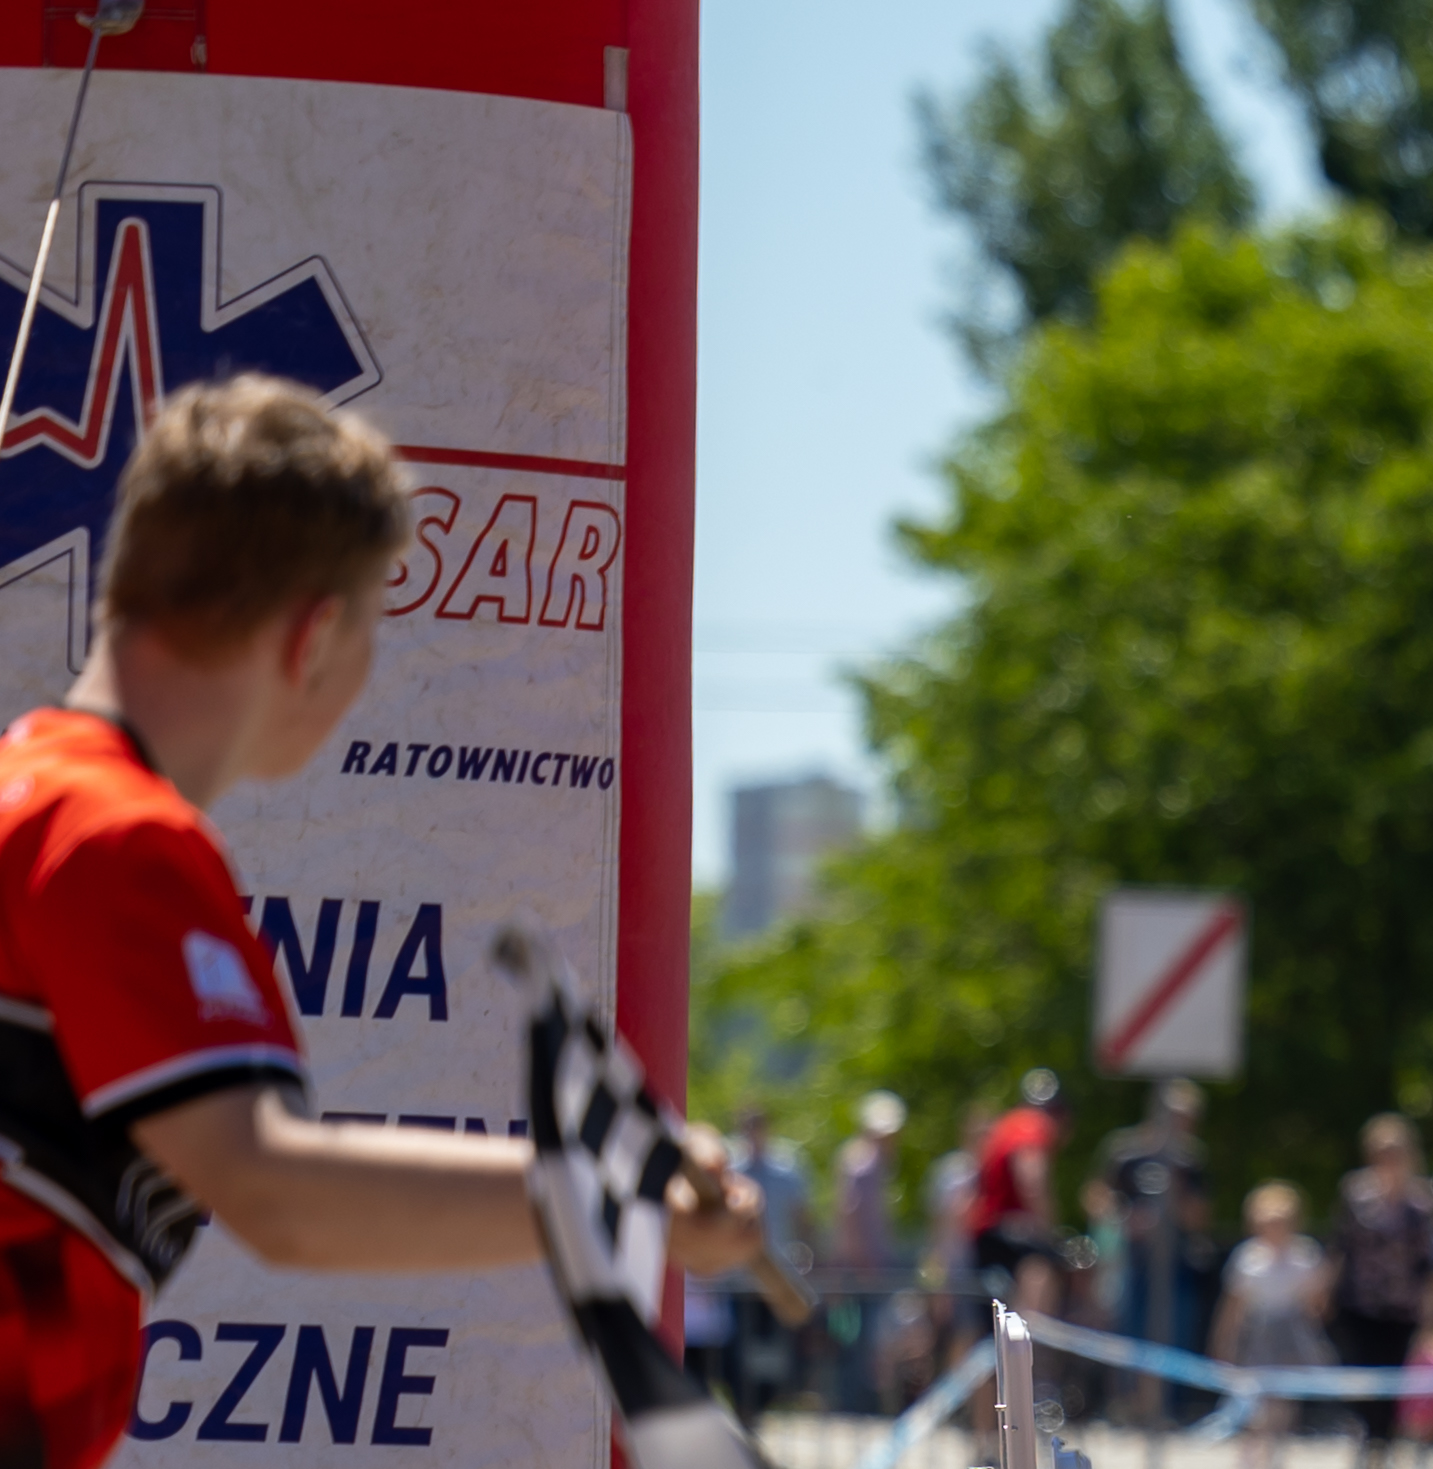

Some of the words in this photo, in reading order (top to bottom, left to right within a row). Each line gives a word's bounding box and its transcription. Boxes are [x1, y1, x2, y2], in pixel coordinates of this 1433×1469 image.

[384, 486, 620, 632] SAR
[341, 740, 615, 791] RATOWNICTWO
[238, 895, 448, 1022] NIA
[125, 1320, 450, 1447] CZNE
